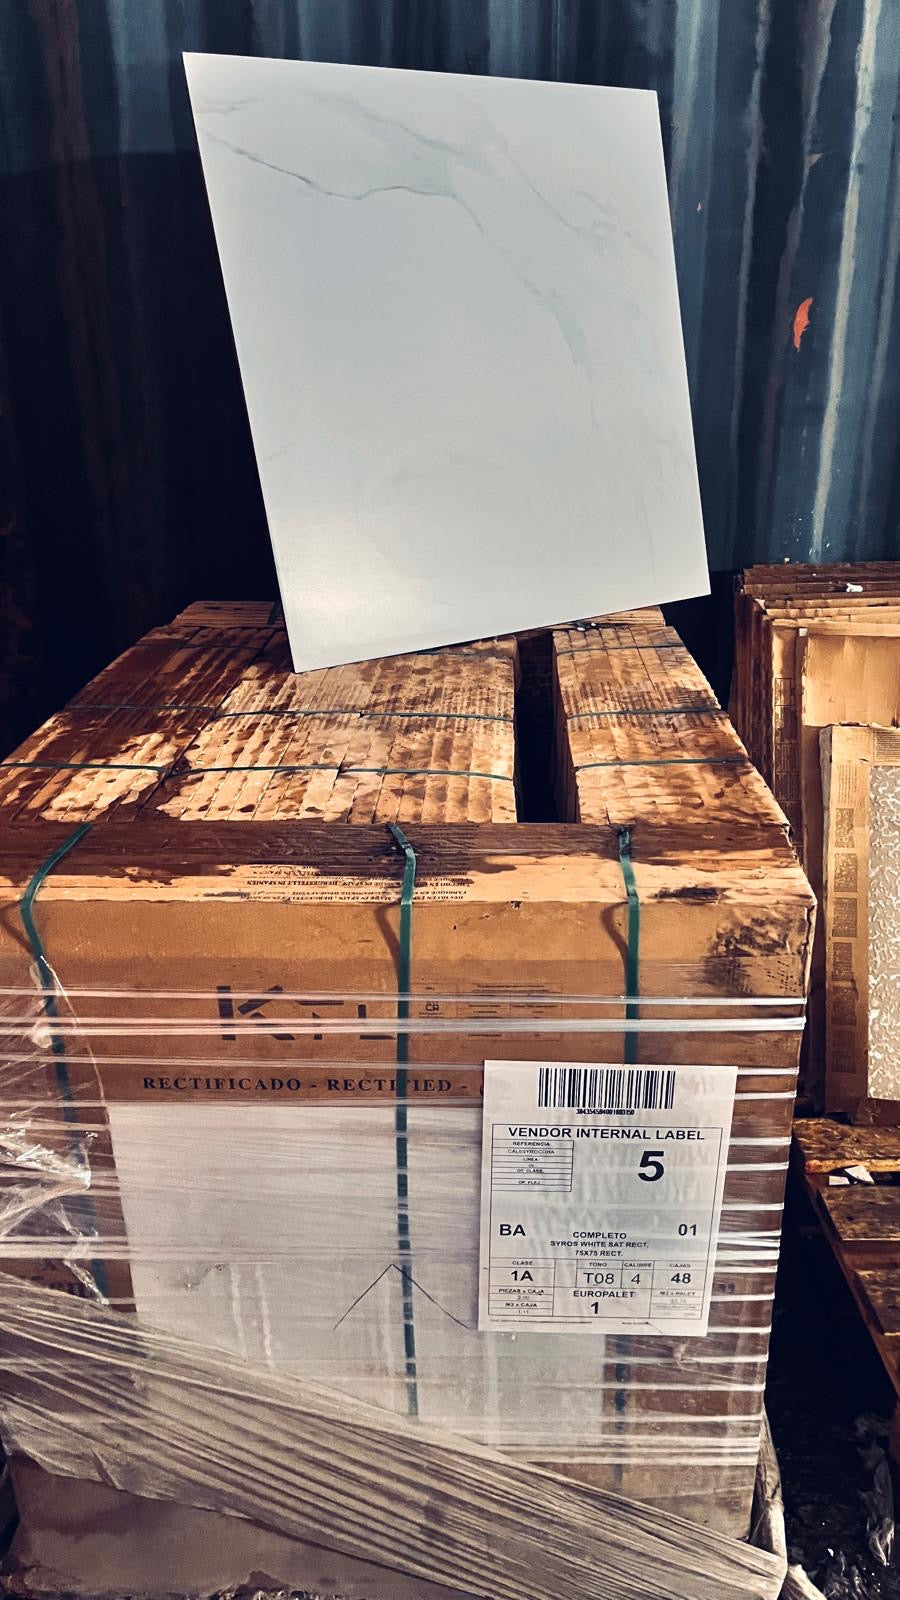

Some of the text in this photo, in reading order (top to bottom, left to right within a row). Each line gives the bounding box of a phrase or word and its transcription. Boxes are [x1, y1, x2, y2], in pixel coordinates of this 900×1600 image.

[143, 1077, 301, 1091] RECTIFICADO
[326, 1078, 452, 1092] RECTIIED
[508, 1128, 705, 1140] VENDOR INTERNAL LABEL
[638, 1151, 664, 1182] 5
[500, 1224, 526, 1236] BA
[678, 1224, 697, 1236] 01
[511, 1270, 533, 1281] 1A
[584, 1272, 614, 1284] T08
[631, 1273, 640, 1284] 4
[671, 1273, 691, 1284] 48
[591, 1302, 598, 1314] 1
